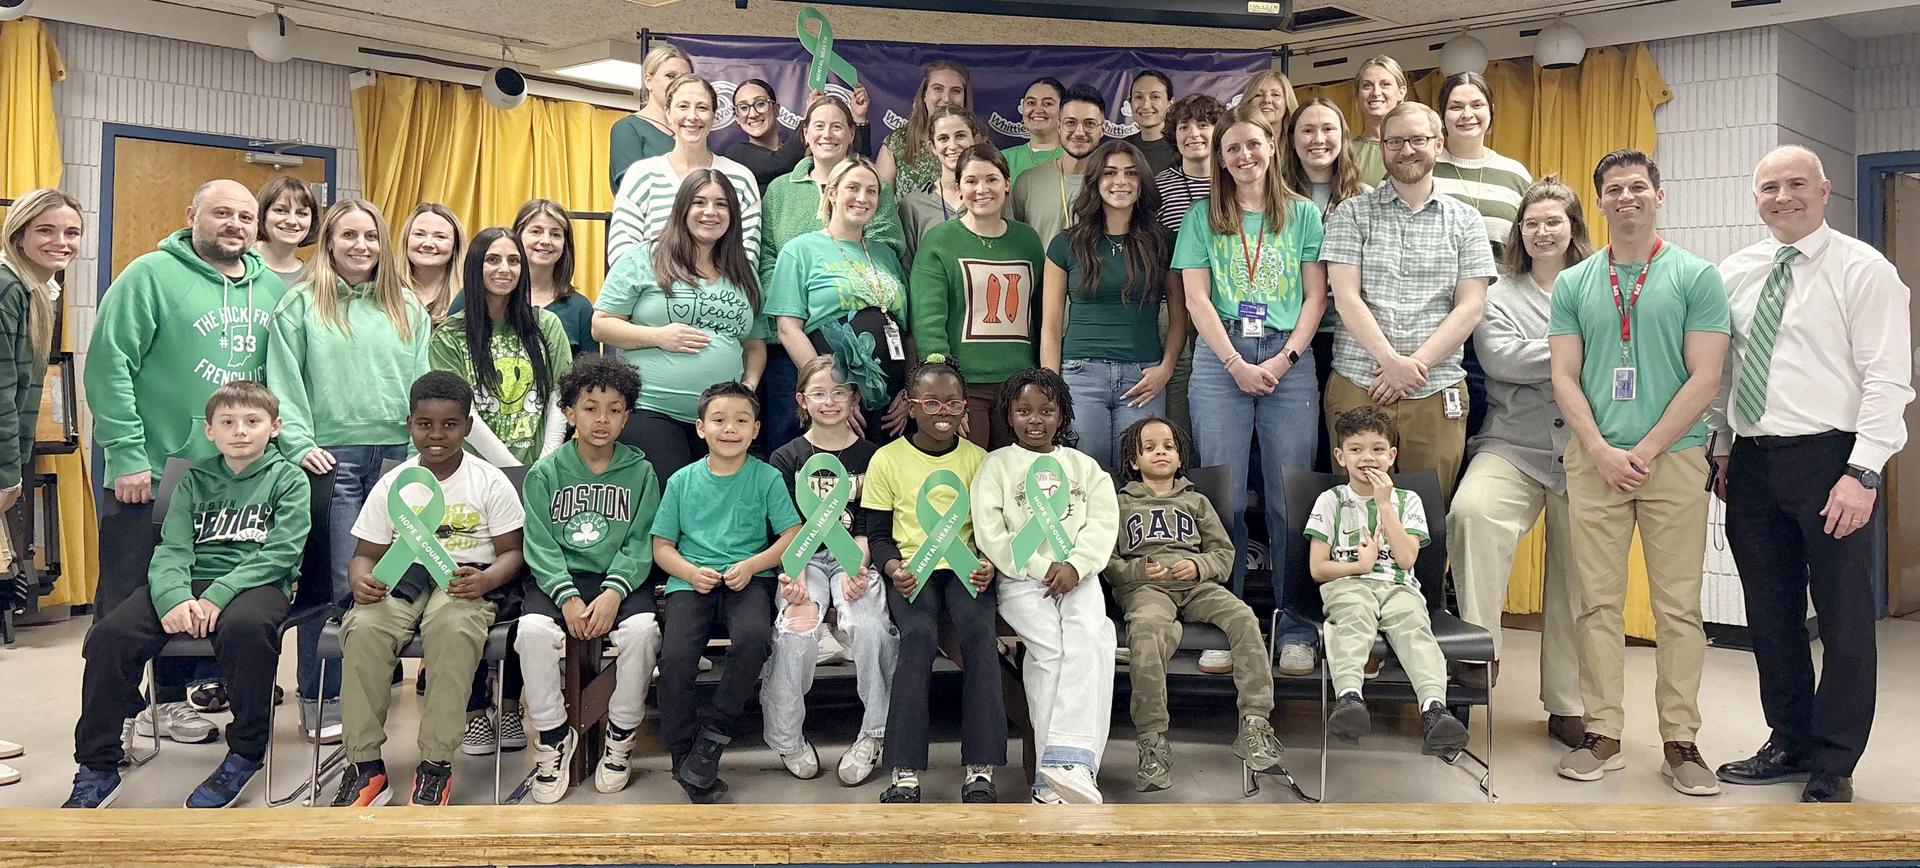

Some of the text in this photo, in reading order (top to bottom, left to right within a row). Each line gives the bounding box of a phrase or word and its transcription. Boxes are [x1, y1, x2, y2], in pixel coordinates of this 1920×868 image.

[816, 36, 829, 82] MENTAL HEALTH
[699, 290, 749, 310] coffee
[699, 301, 748, 325] teach
[193, 310, 219, 337] THE
[253, 308, 271, 331] FR
[695, 317, 746, 338] repeat
[567, 513, 607, 531] CELTICS
[795, 498, 840, 559] MENTAL HEALTH
[916, 513, 959, 574] MENTAL HEALTH
[1033, 495, 1048, 517] HOPE
[1049, 524, 1070, 555] COURAG
[1126, 507, 1195, 551] GAP
[398, 513, 452, 576] HOPE & COURAGE
